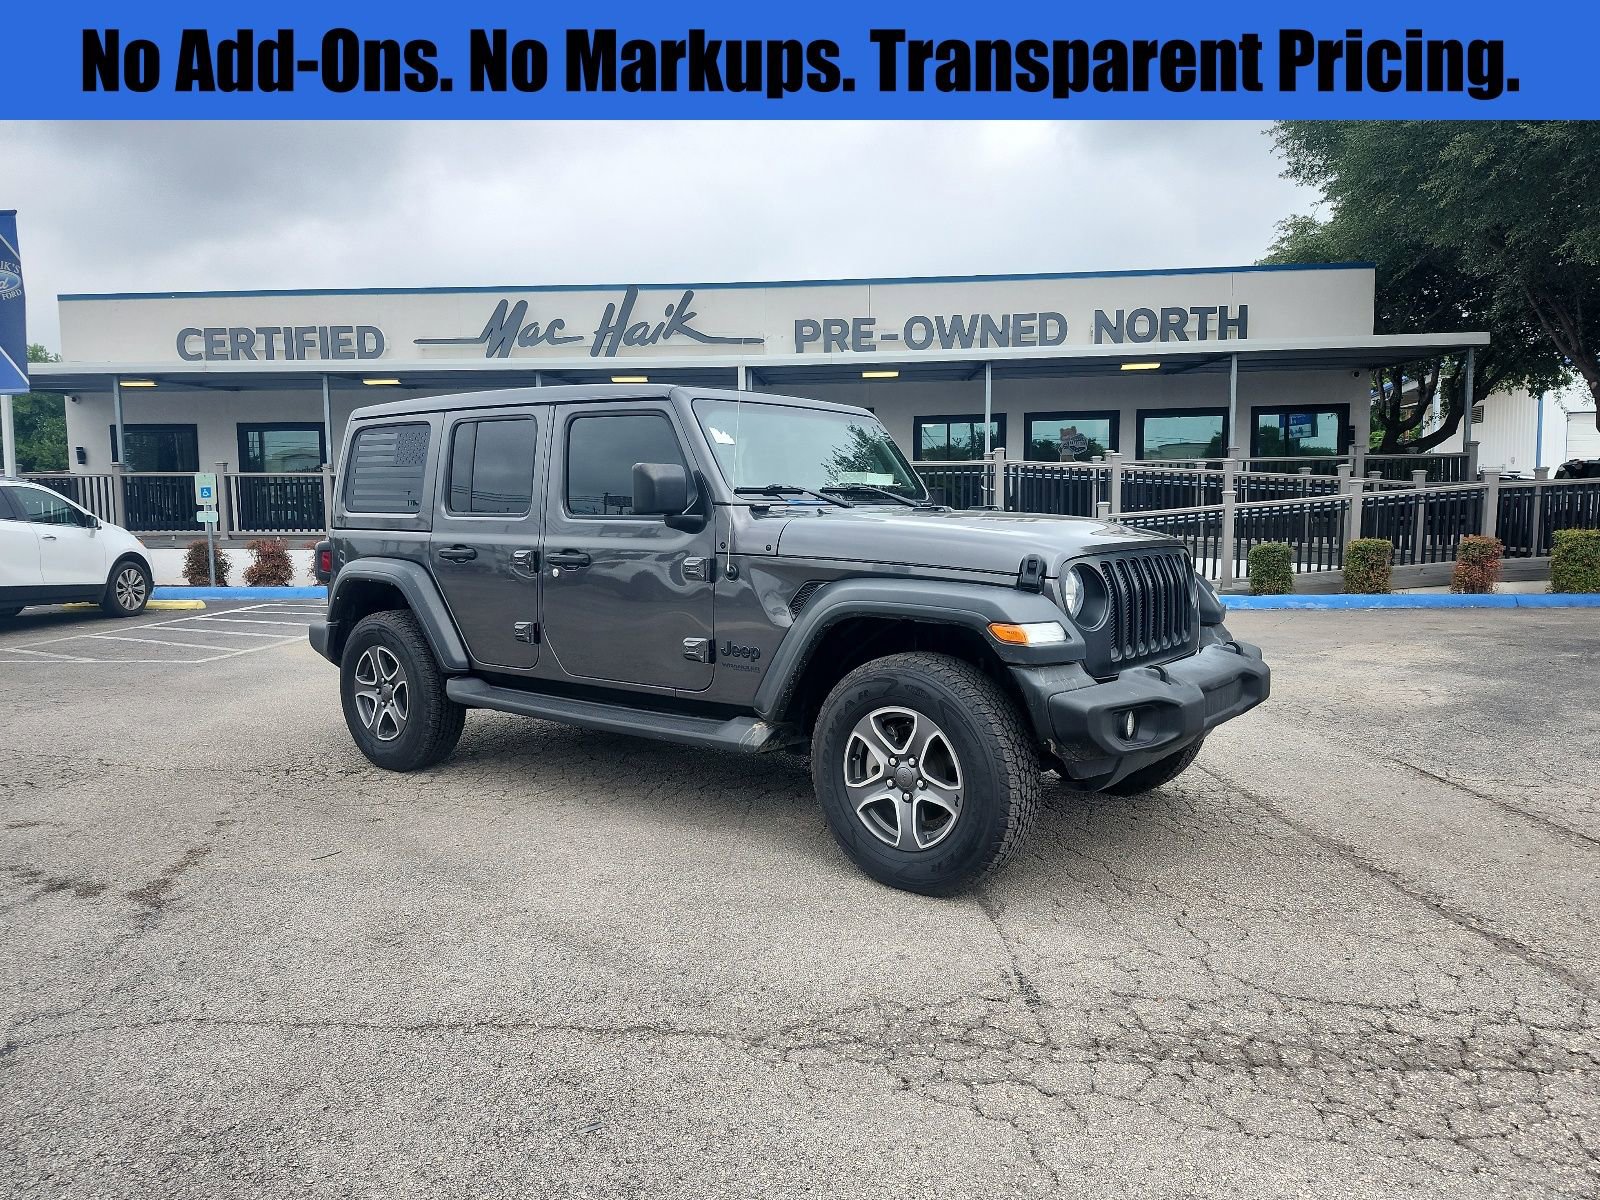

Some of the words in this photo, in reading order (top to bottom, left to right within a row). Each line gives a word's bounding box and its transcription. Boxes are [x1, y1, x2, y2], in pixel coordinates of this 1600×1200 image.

[0, 261, 20, 273] IK'S
[2, 289, 21, 300] FORD
[176, 325, 385, 361] CERTIFIED
[413, 299, 585, 358] Mac
[589, 285, 765, 358] Haik
[794, 312, 1068, 353] PRE-OWNED
[1094, 304, 1249, 344] NORTH
[720, 640, 760, 662] Jeep
